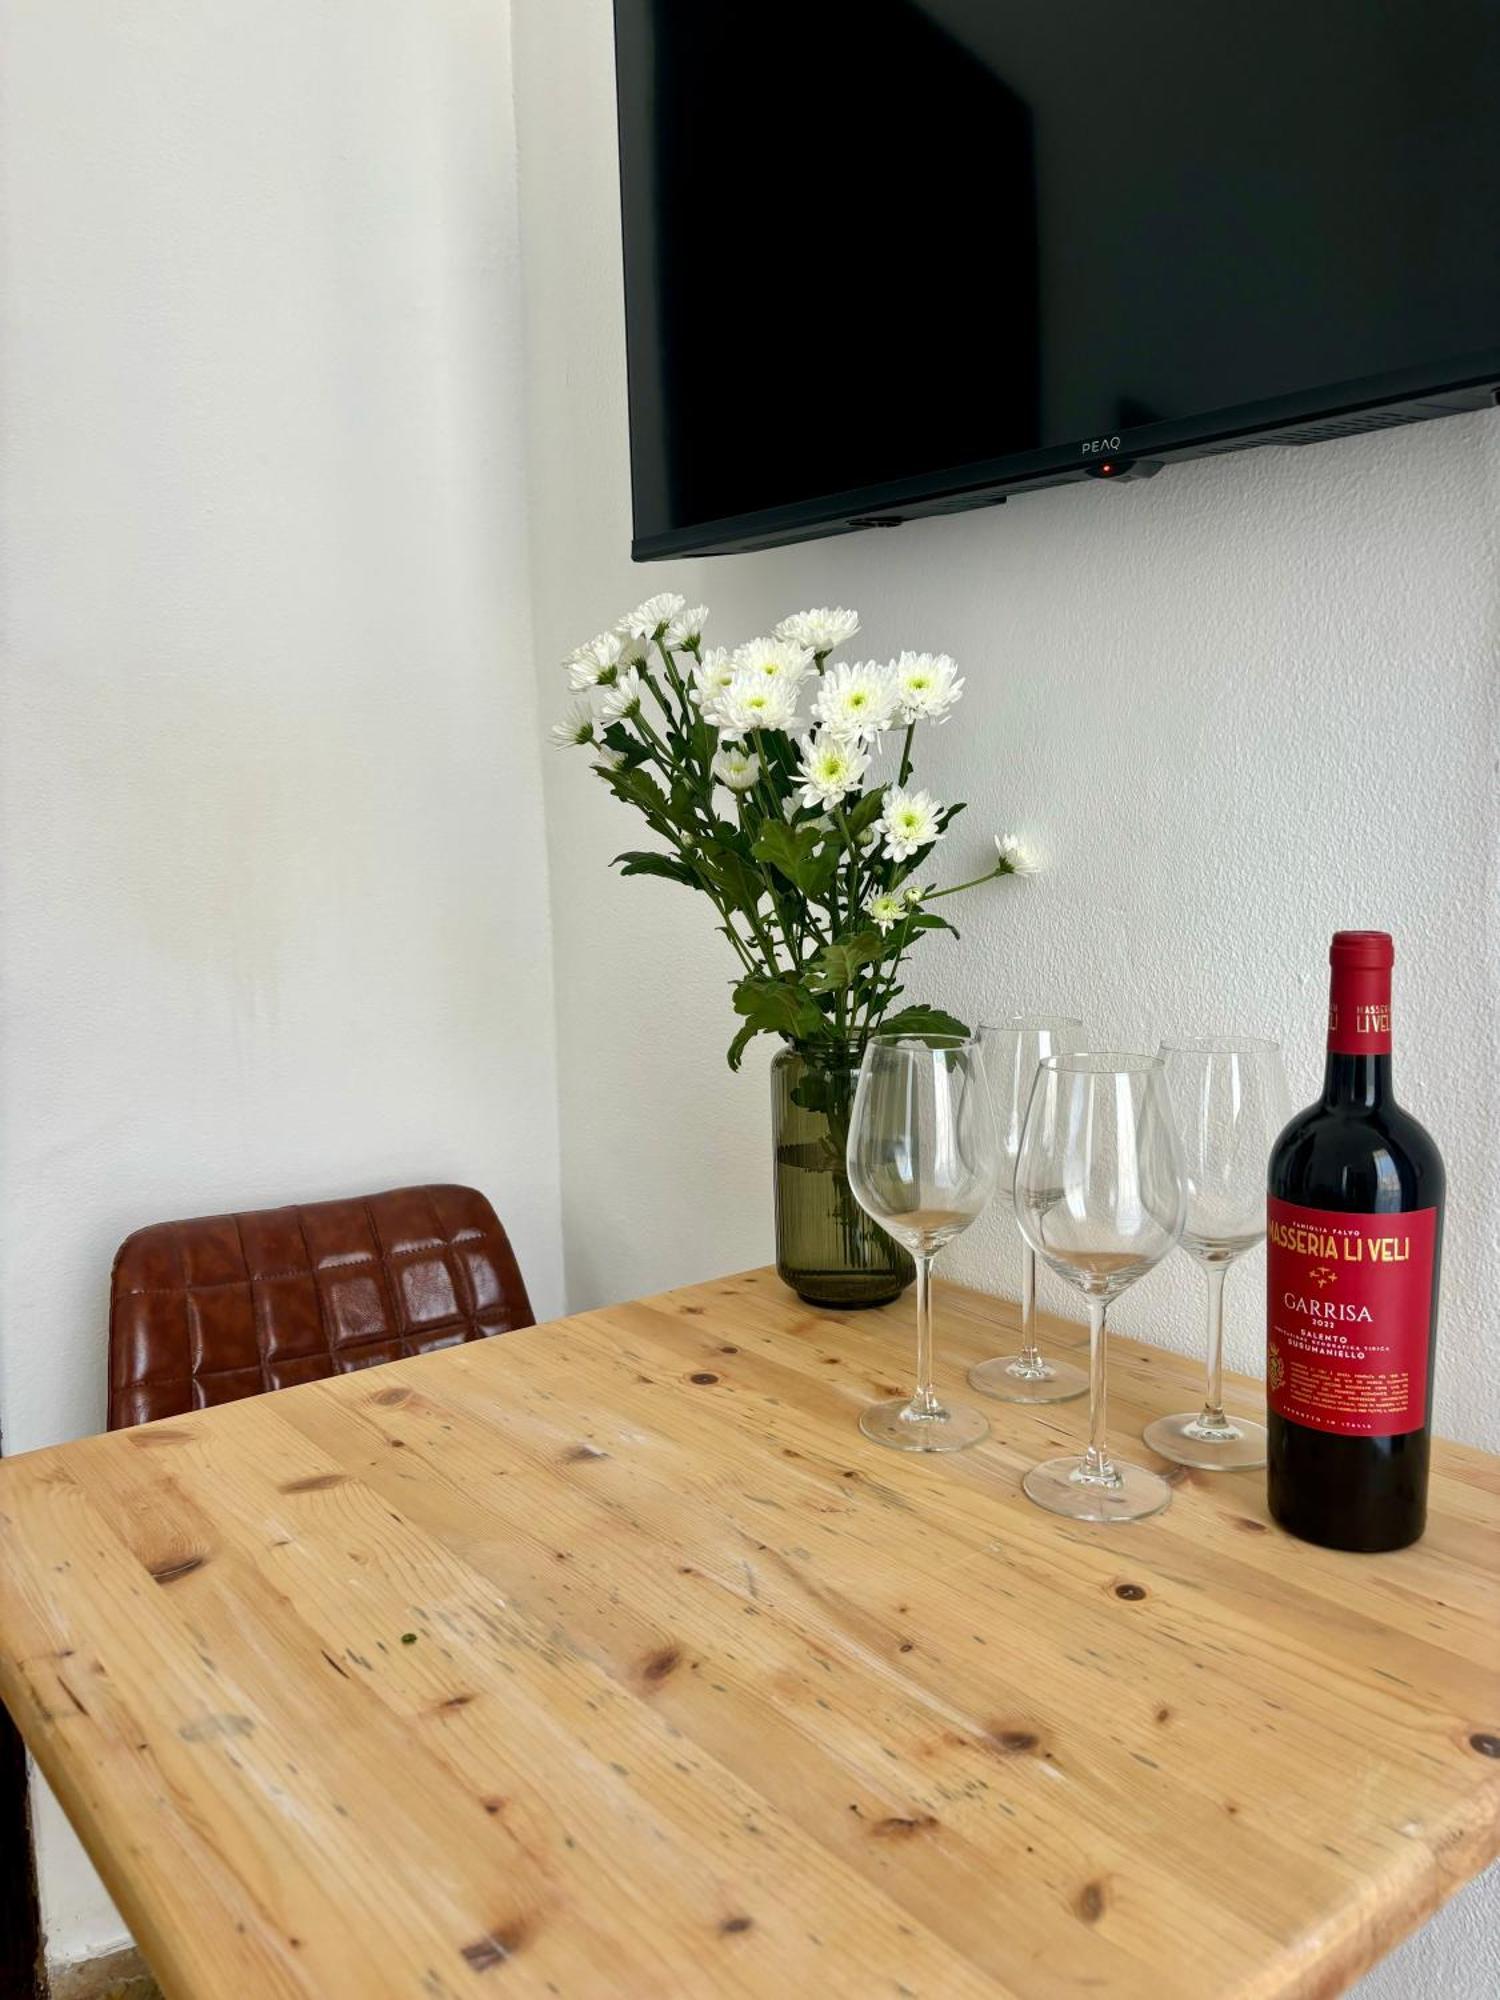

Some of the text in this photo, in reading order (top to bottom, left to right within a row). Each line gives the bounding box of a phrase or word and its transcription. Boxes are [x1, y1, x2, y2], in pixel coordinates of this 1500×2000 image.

[1082, 436, 1121, 454] PEAQ
[1343, 1237, 1362, 1261] LI
[1367, 1236, 1409, 1262] VELI
[1284, 1292, 1373, 1322] GARRISA
[1300, 1328, 1348, 1344] SALENTO
[1287, 1338, 1366, 1360] SUSUMANIELLO
